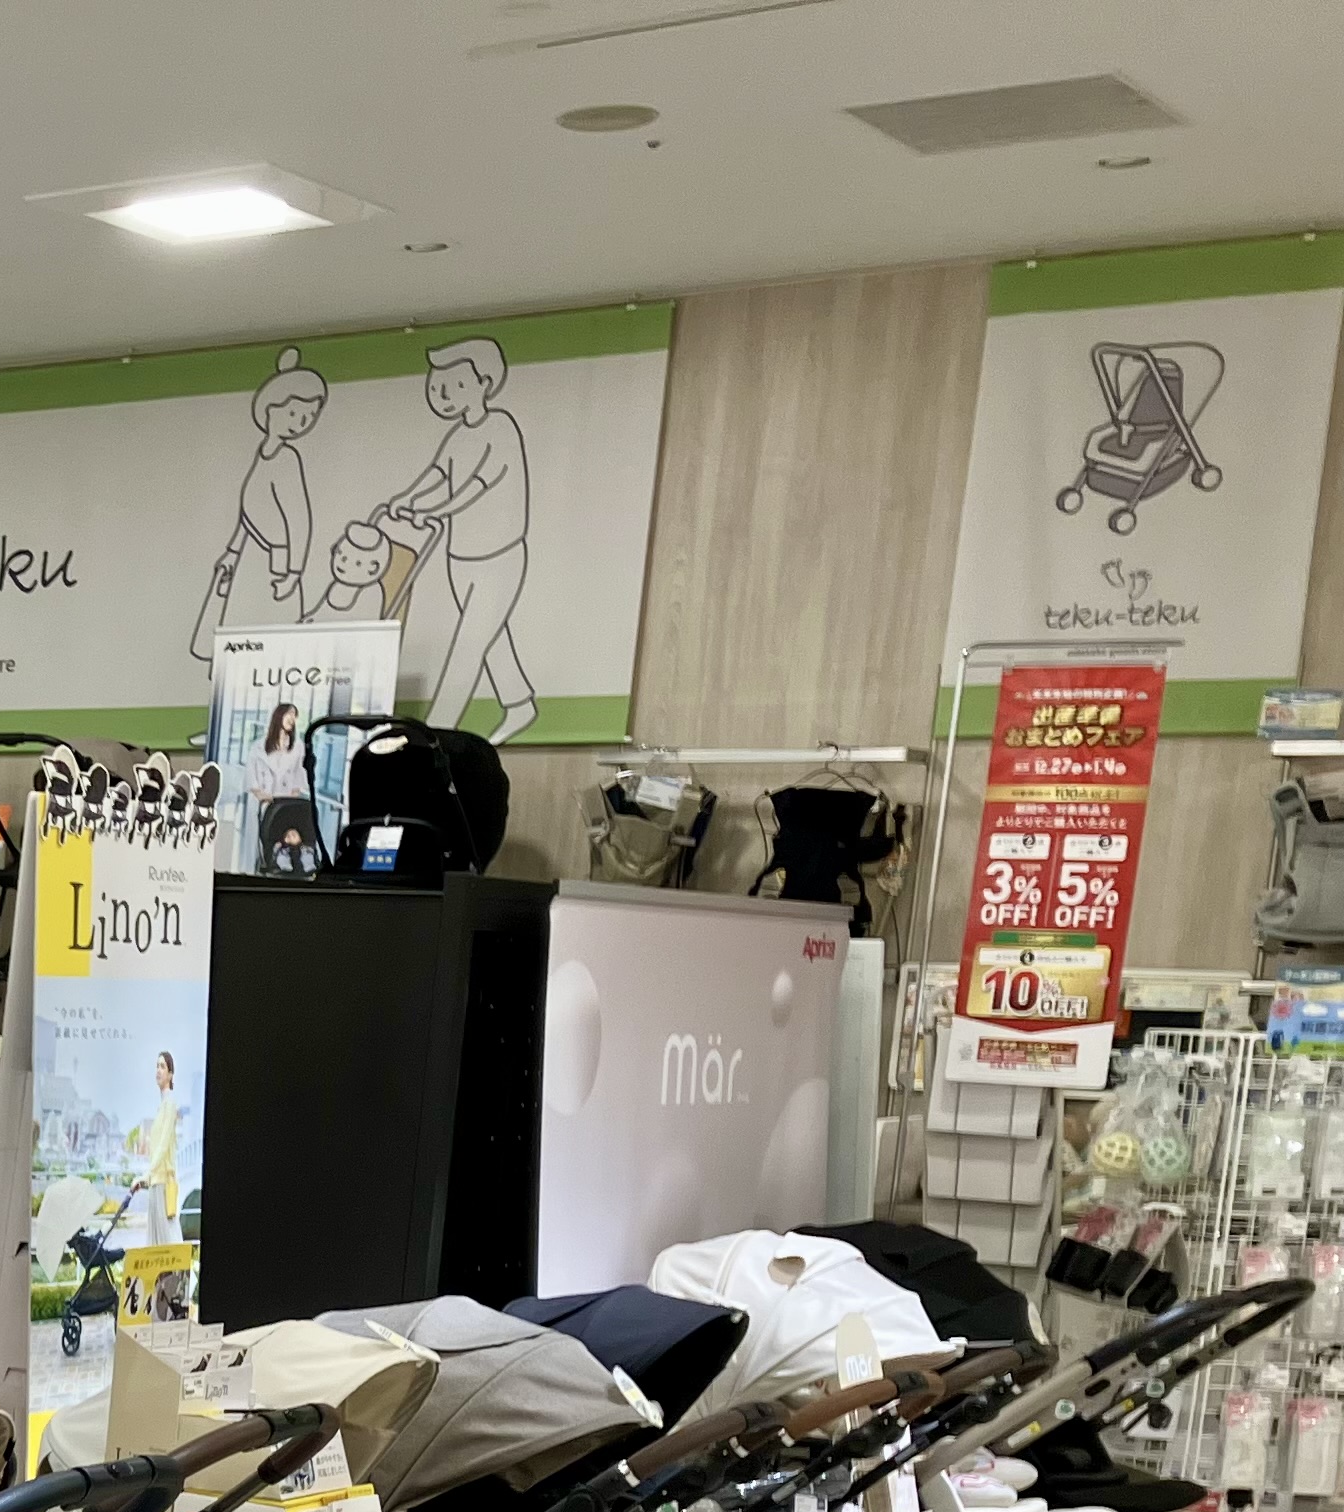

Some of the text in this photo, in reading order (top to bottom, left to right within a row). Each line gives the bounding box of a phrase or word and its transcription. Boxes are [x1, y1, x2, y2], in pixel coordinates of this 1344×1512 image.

[1043, 600, 1201, 631] teku-teku
[982, 860, 1120, 907] 3% 5%
[980, 903, 1116, 929] OFF! OFF!
